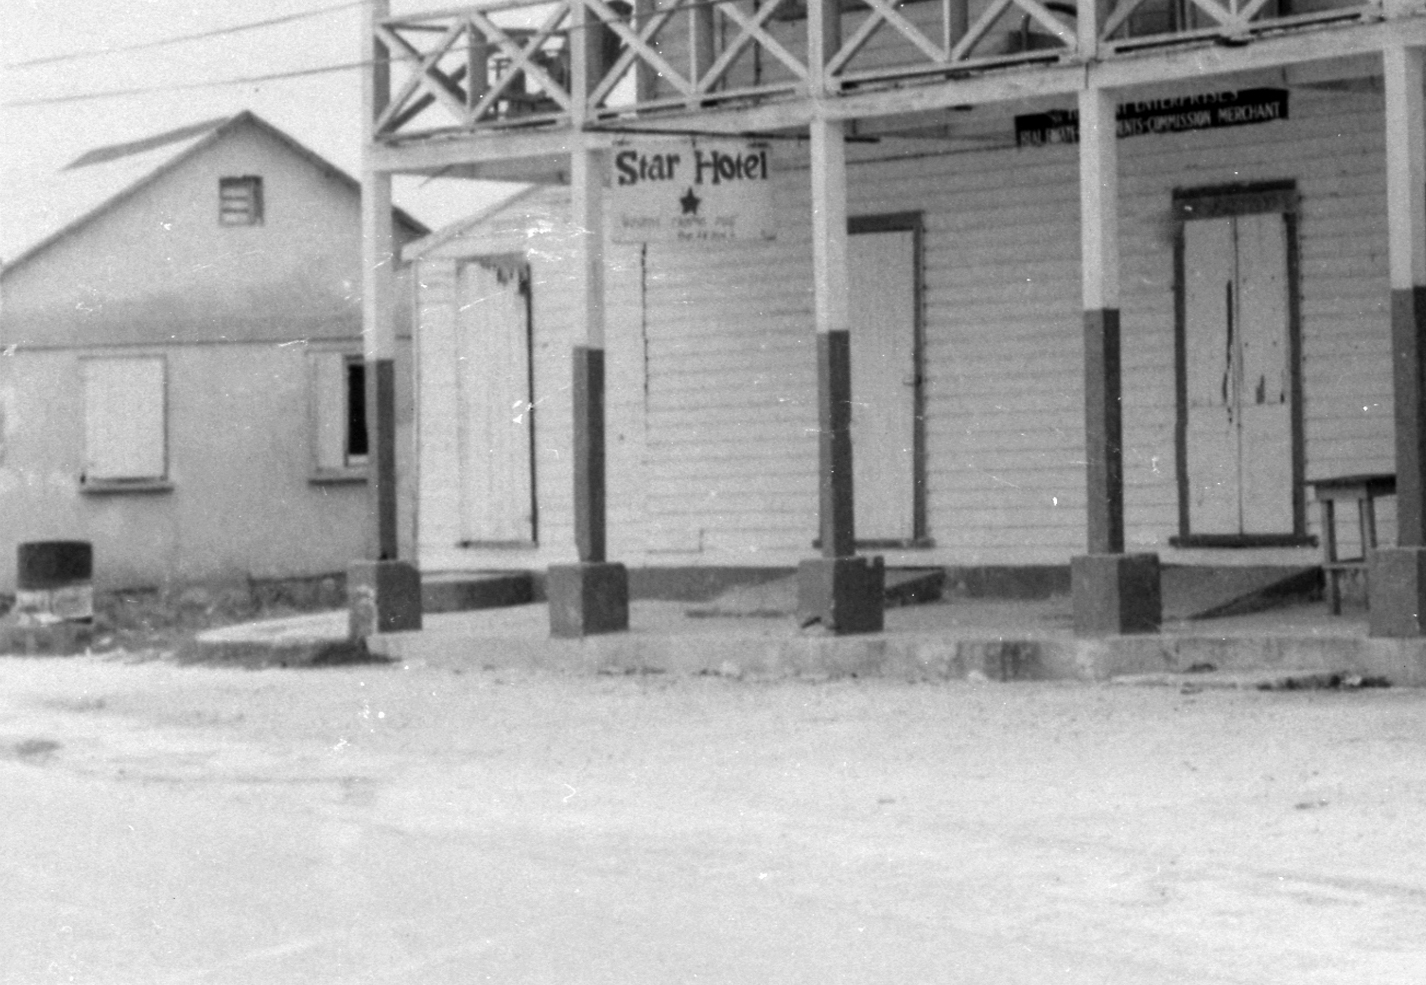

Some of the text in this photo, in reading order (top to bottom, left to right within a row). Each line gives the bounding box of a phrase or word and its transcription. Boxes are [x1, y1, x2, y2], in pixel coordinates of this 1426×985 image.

[1217, 100, 1281, 123] MERCHANT
[615, 149, 768, 186] Star Hotel
